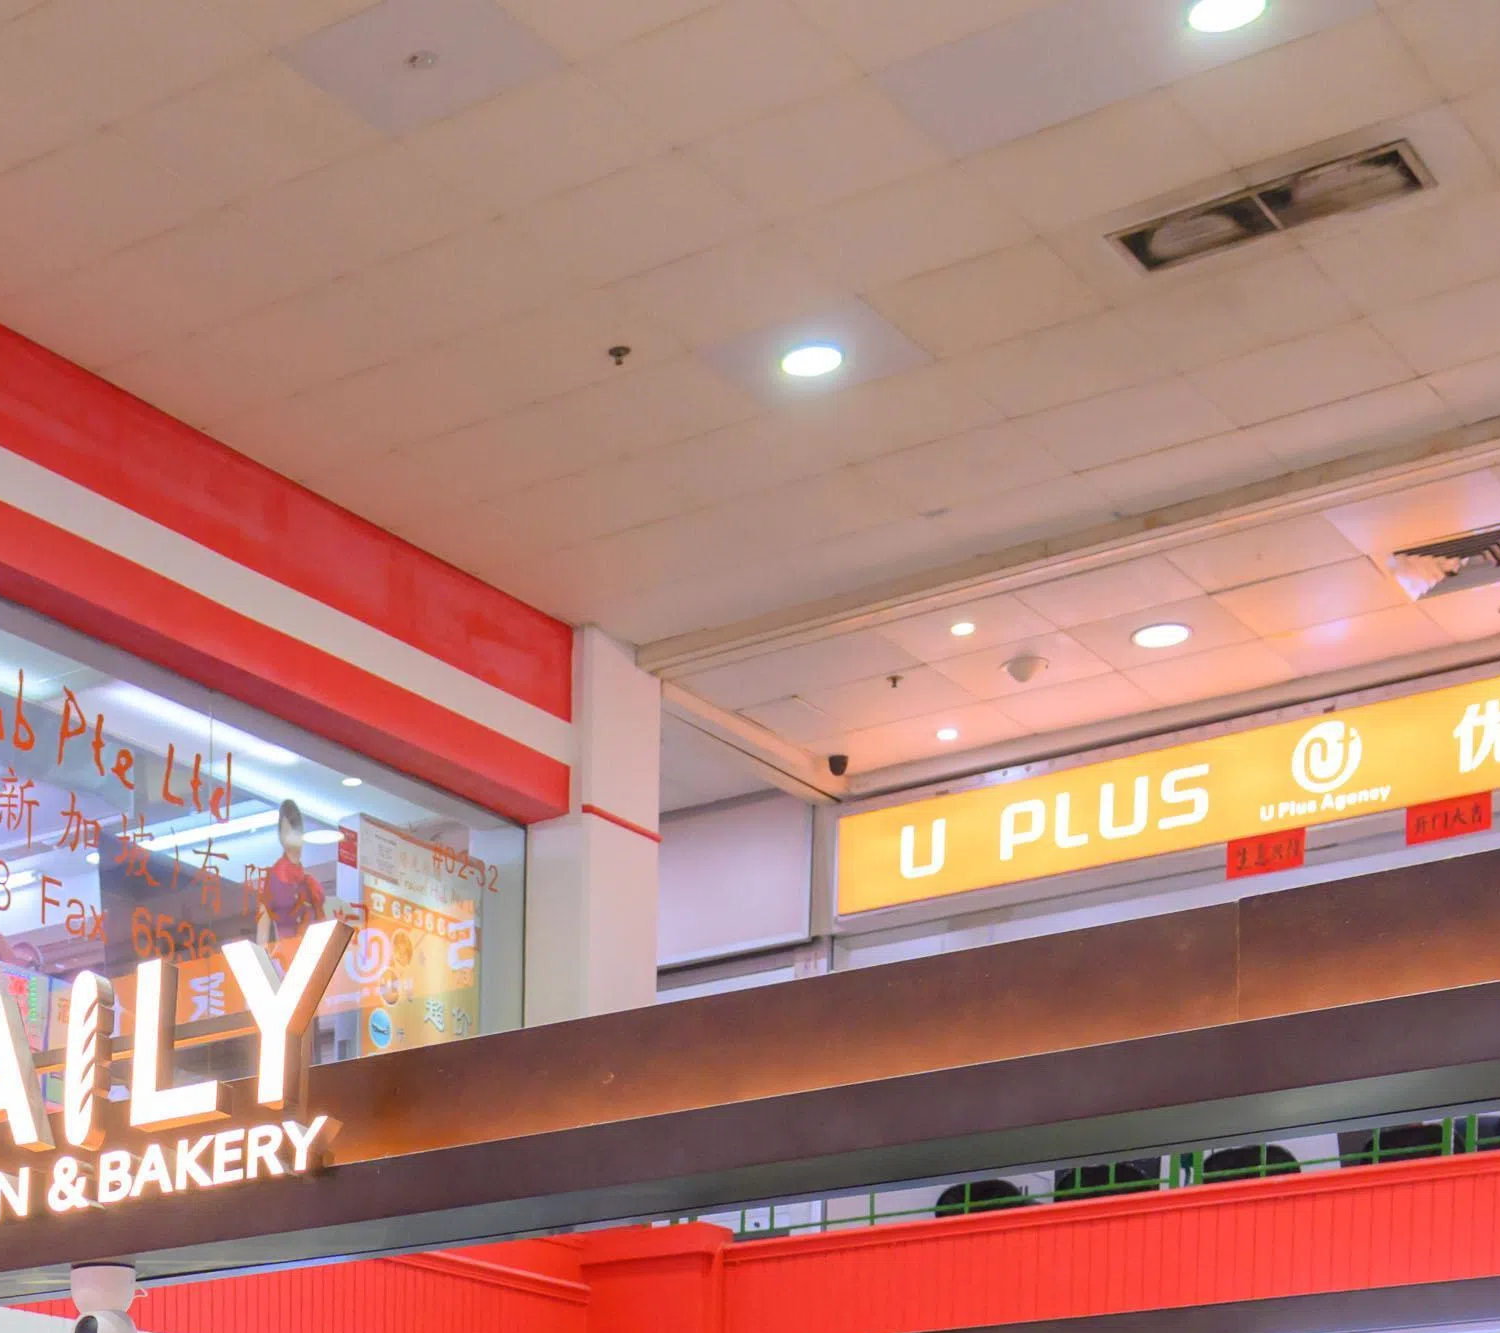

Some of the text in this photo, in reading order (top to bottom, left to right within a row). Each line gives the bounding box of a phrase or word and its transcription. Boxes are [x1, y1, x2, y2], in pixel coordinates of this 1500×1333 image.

[58, 686, 135, 791] Pte
[162, 742, 232, 824] Ltd
[900, 764, 1211, 881] U PLUS
[1259, 784, 1392, 822] U Plus Agency
[41, 874, 106, 944] Fax
[432, 846, 499, 893] #02-32
[46, 1156, 90, 1212] &
[99, 1116, 329, 1204] BAKERY
